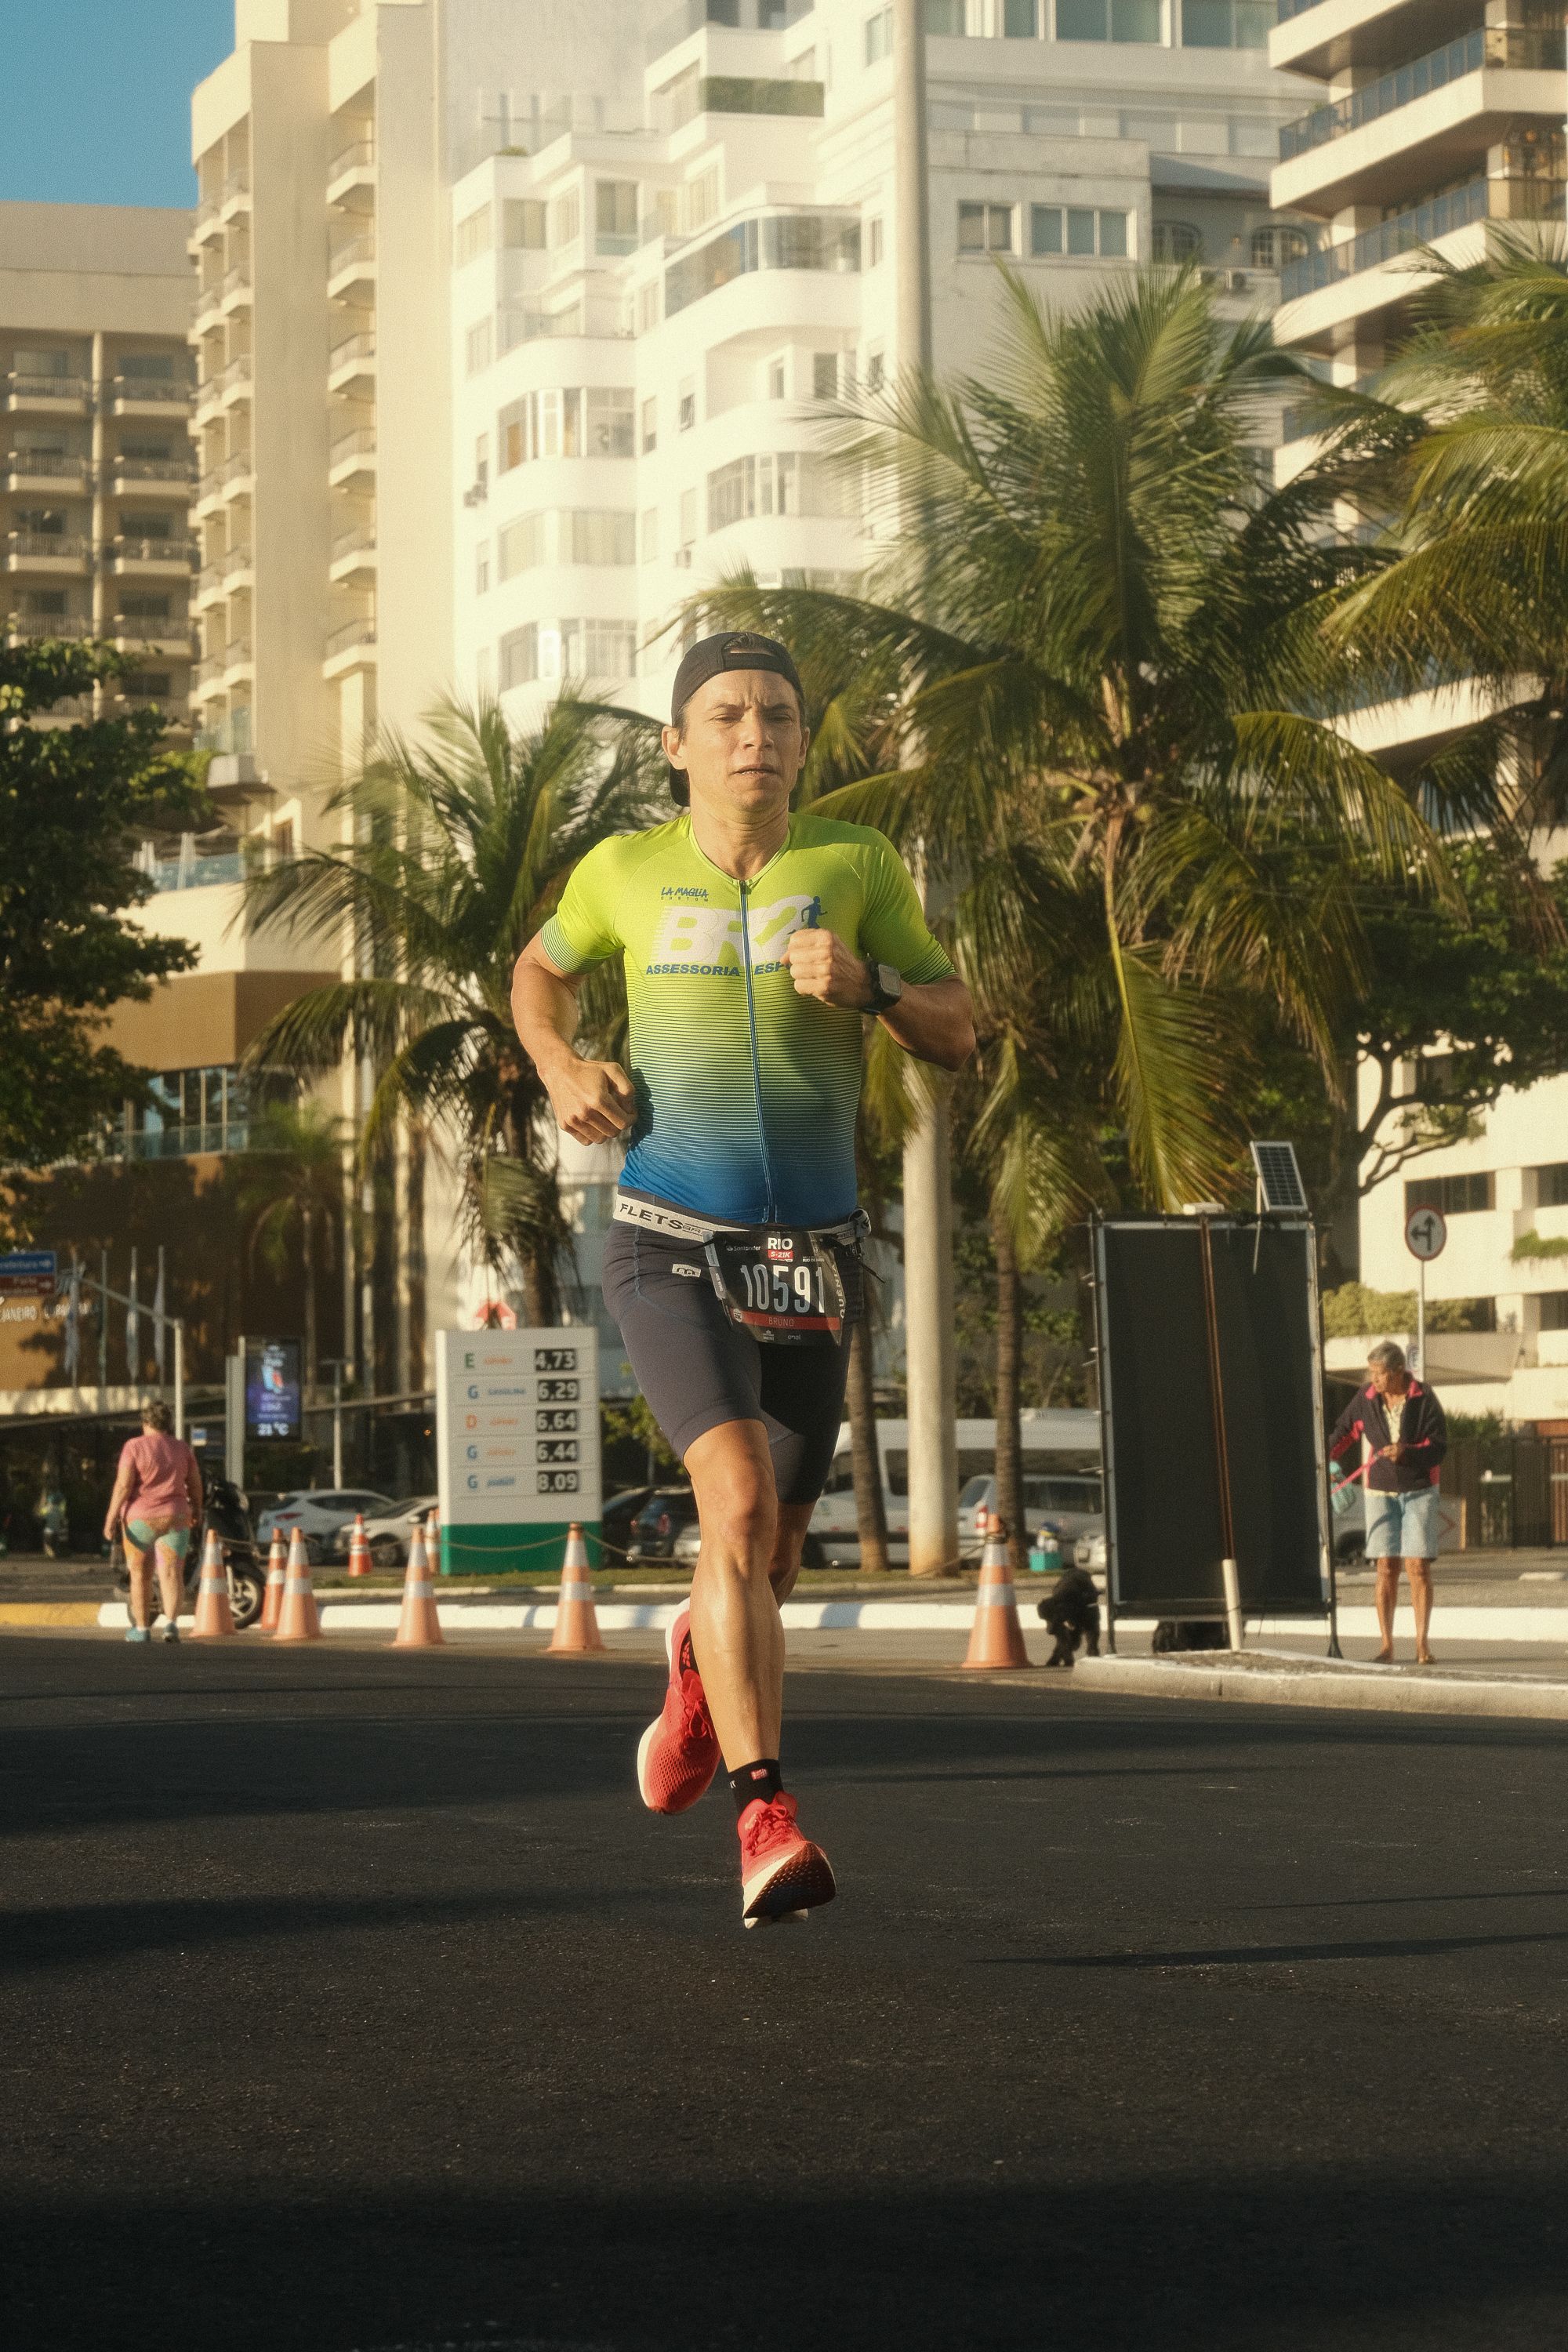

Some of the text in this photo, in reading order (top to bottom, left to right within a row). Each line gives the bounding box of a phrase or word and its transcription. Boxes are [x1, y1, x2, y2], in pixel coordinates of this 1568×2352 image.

[661, 887, 673, 895] LA
[646, 964, 740, 976] ASSESSORIA
[619, 1203, 683, 1229] FLETS
[768, 1237, 793, 1250] RIO
[740, 1264, 825, 1313] 10591
[768, 1316, 794, 1327] BRUNO
[464, 1352, 474, 1369] E
[467, 1385, 479, 1399] G
[465, 1414, 477, 1430] D
[466, 1445, 477, 1460] G
[467, 1474, 478, 1490] G
